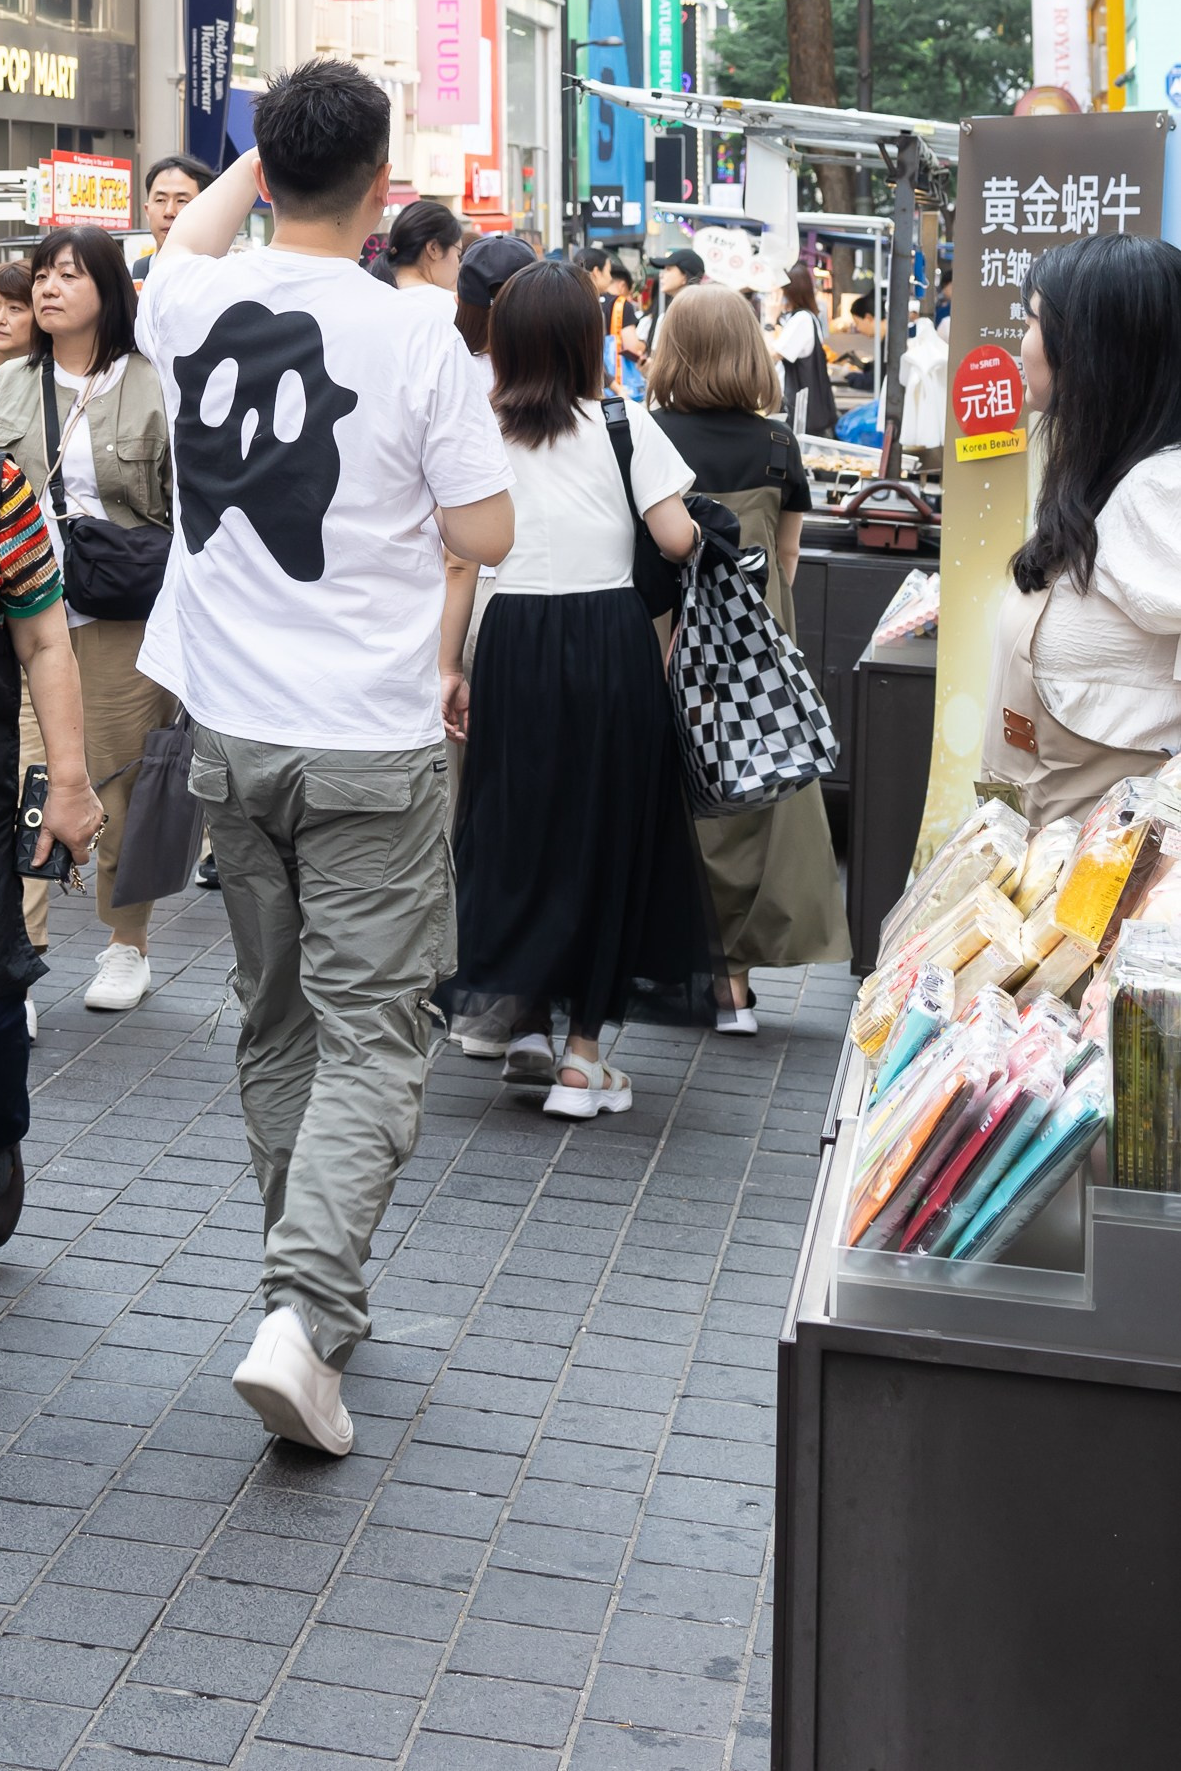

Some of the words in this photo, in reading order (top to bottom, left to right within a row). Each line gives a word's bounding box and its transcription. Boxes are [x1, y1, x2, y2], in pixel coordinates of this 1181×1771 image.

[213, 18, 230, 78] Rockfish
[1053, 7, 1071, 77] ROYAL
[34, 51, 78, 99] MART
[201, 25, 216, 115] Weatherwear
[70, 173, 97, 209] LAMB
[980, 173, 1141, 235] 黄金蜗牛
[981, 248, 1039, 287] 抗皱
[960, 378, 1016, 423] 元祖
[962, 440, 987, 453] Korea
[990, 436, 1020, 450] Beauty
